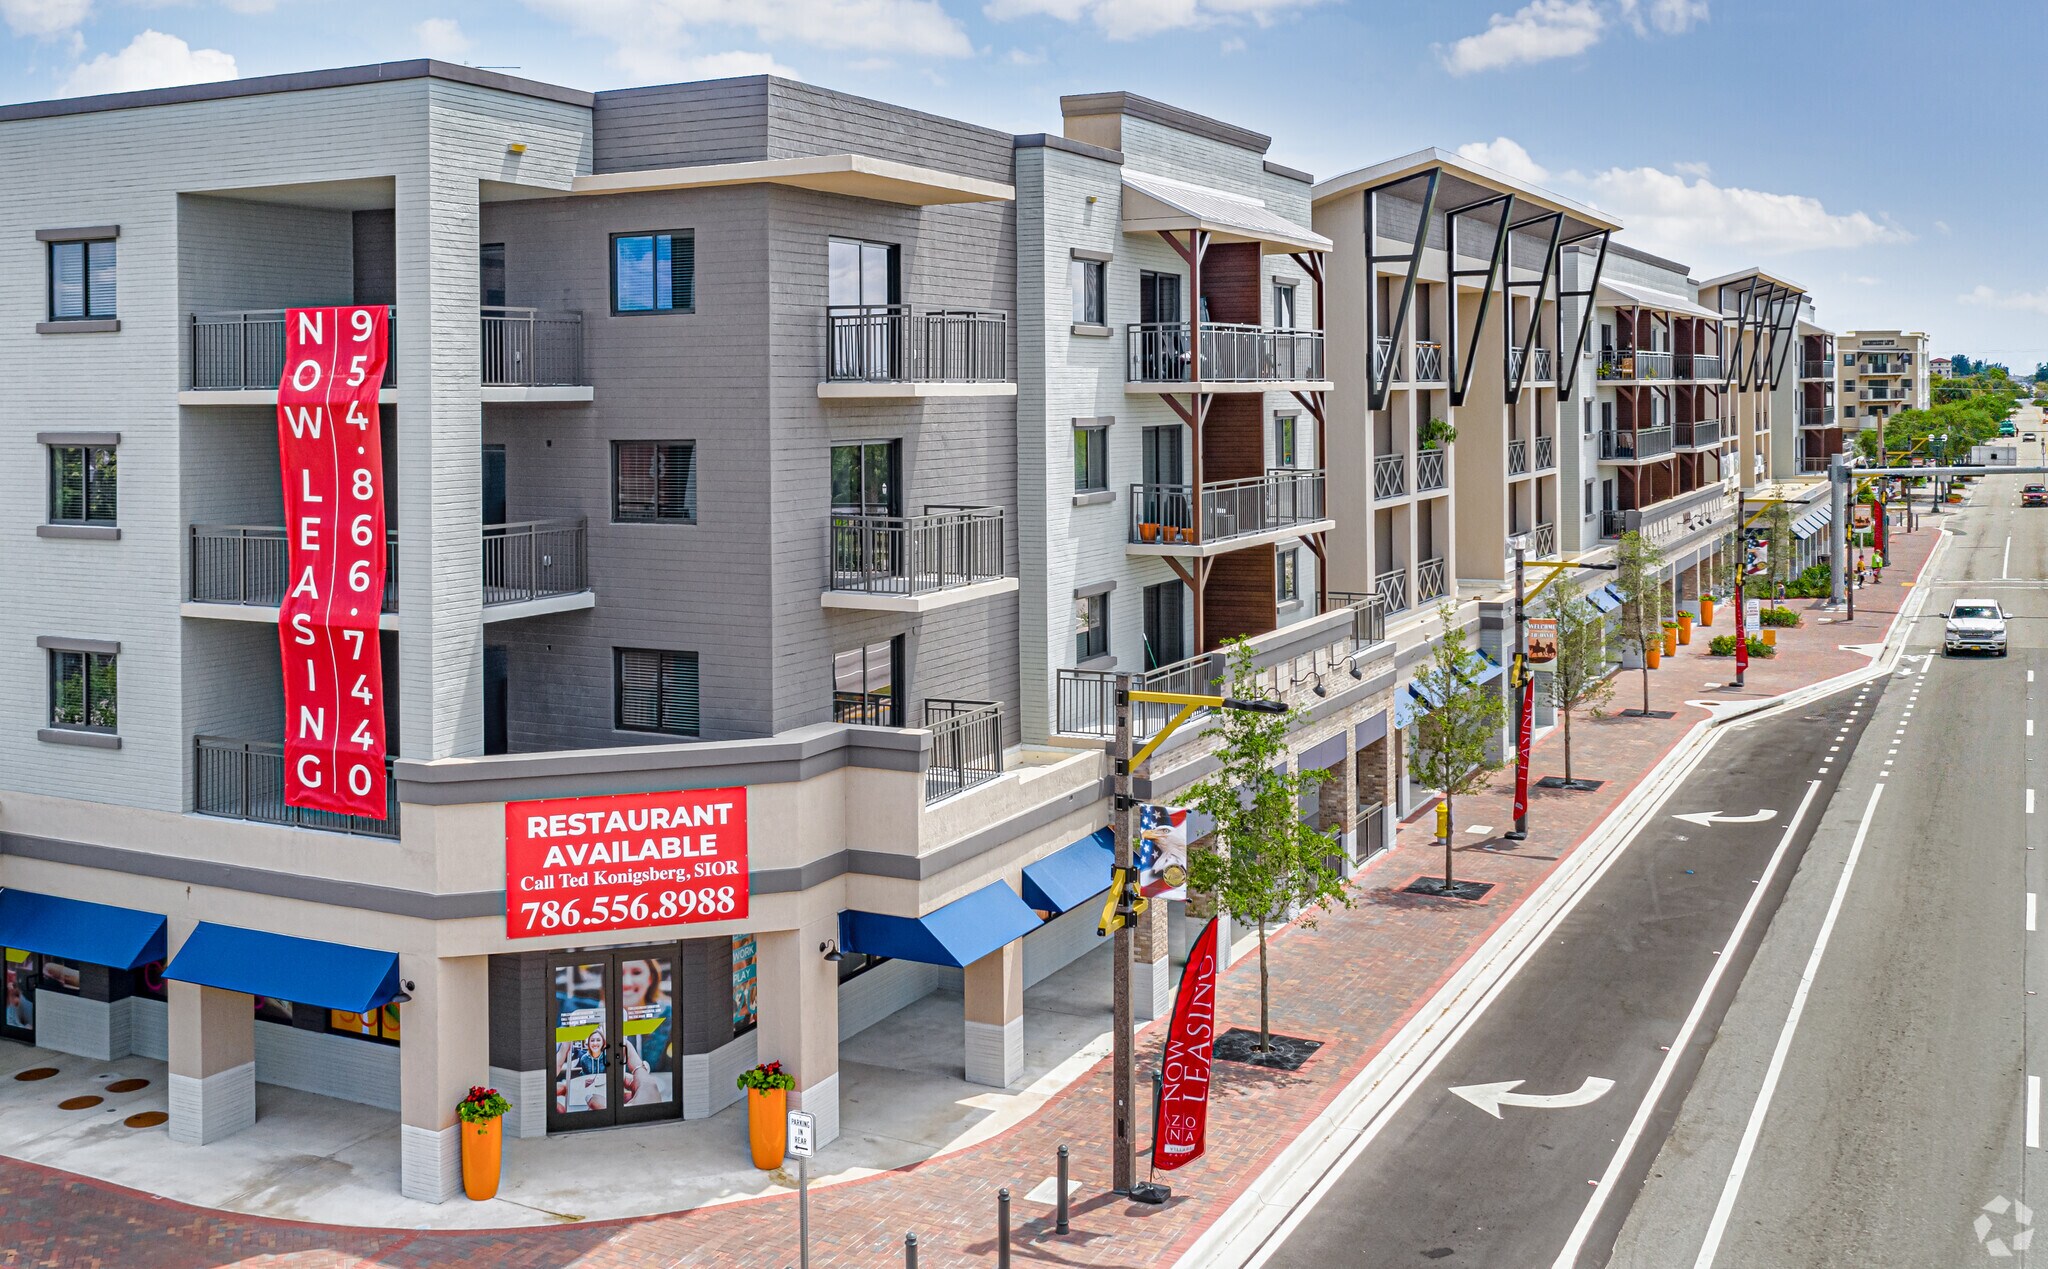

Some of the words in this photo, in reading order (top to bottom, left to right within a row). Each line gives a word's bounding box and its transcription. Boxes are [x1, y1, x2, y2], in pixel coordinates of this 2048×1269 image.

[284, 311, 323, 439] NOW
[343, 310, 374, 796] 954.866.7440
[291, 469, 325, 788] LEASING
[527, 802, 733, 839] RESTAURANT
[543, 834, 718, 868] AVAILABLE
[520, 872, 554, 891] Call
[559, 869, 589, 888] Ted
[593, 866, 691, 886] Konigsberg,
[694, 860, 739, 878] SIOR
[520, 886, 735, 930] 786.556.8988
[733, 945, 754, 961] WORK
[733, 969, 751, 983] PLAY
[1164, 1040, 1185, 1101] NOW
[791, 1118, 810, 1128] PARKING
[794, 1136, 807, 1145] REAR
